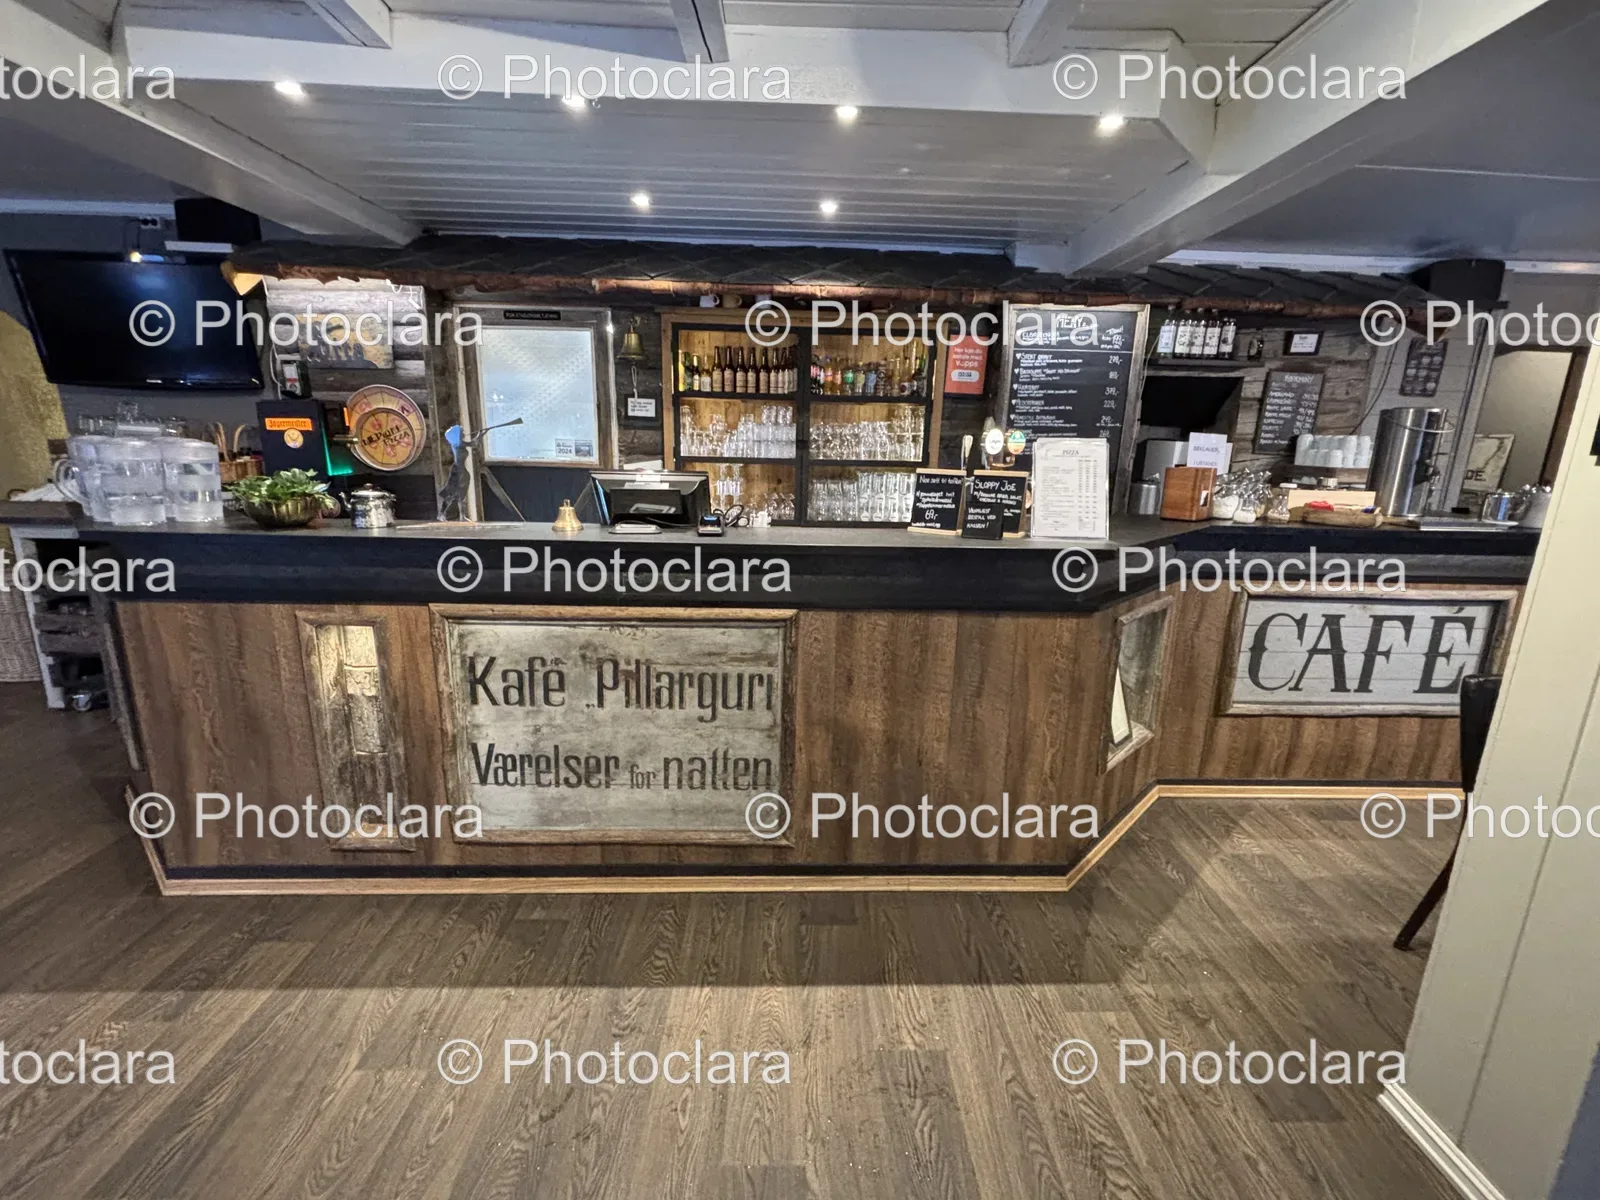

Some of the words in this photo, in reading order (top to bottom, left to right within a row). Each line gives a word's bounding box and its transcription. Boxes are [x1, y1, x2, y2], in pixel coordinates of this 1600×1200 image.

[974, 479, 1000, 491] SLOPPY
[1000, 480, 1016, 491] JOE
[1248, 607, 1476, 693] CAFÉ
[471, 743, 620, 789] Værelser
[629, 764, 657, 790] for
[663, 749, 774, 791] natten
